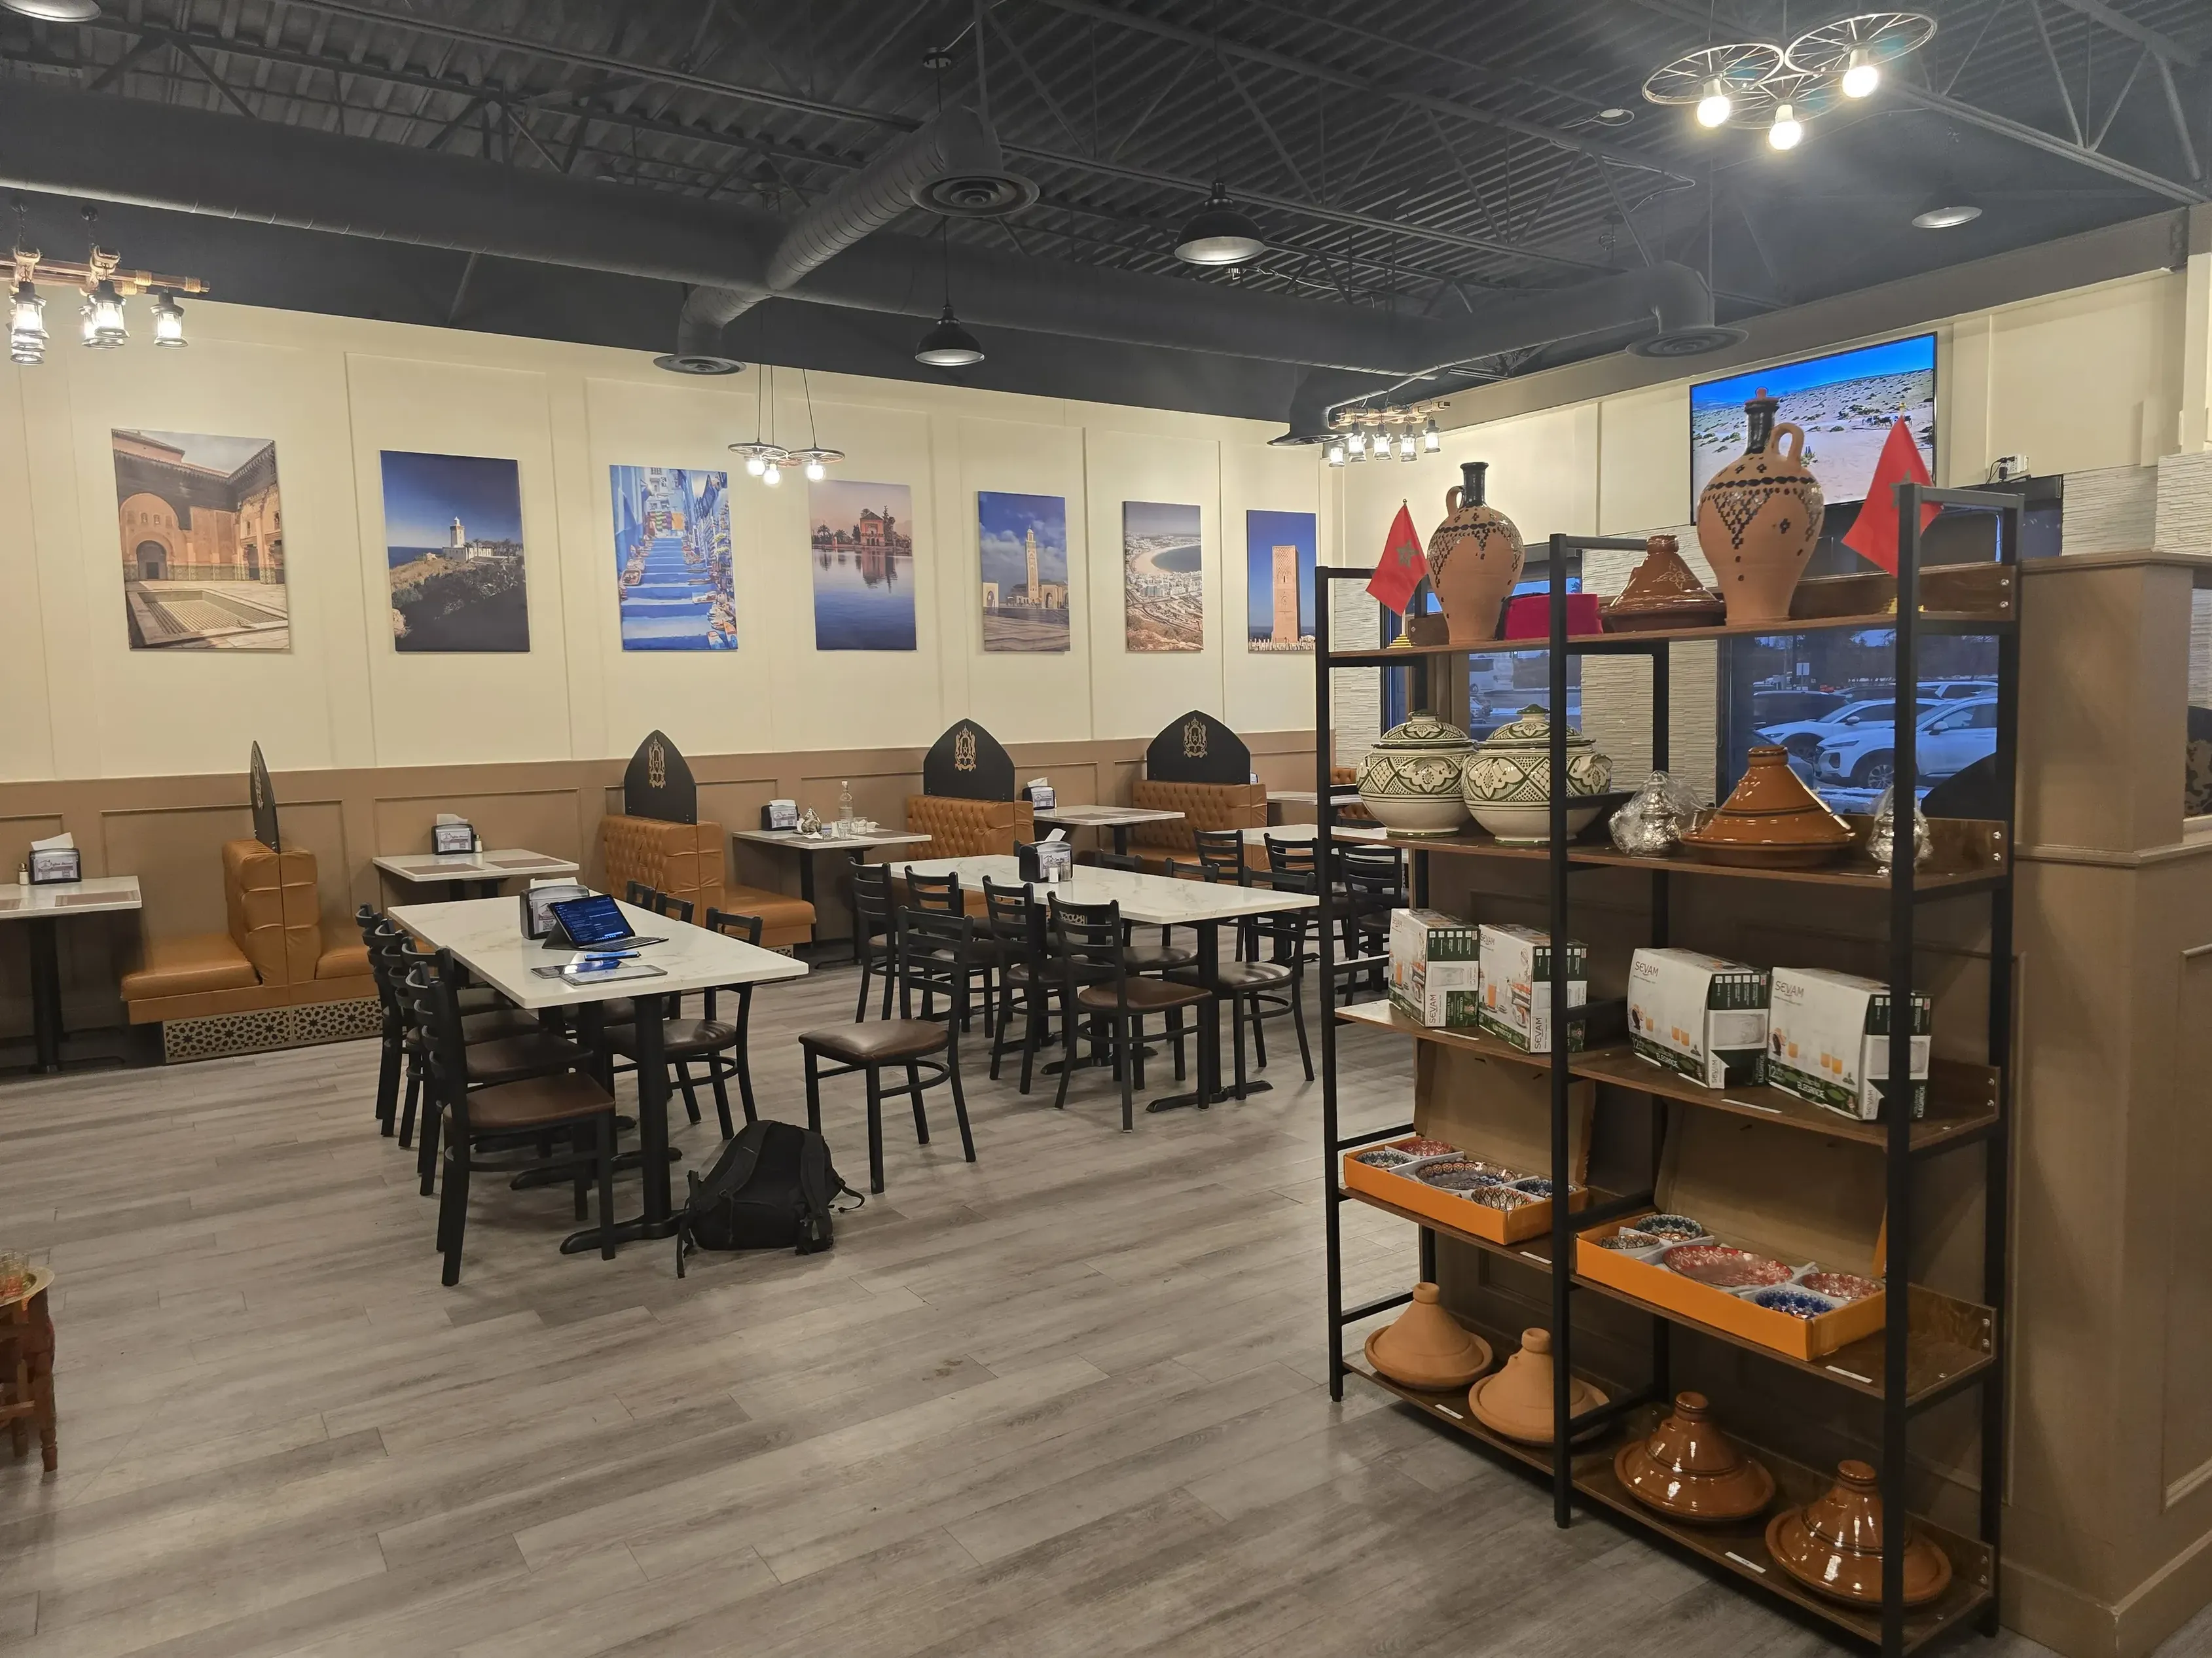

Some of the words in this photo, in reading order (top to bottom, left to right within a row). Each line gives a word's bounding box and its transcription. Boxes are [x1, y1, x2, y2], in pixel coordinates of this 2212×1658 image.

[1480, 933, 1495, 945] SEVAM
[1635, 961, 1659, 977] SEVAM
[1775, 981, 1804, 998] SEVAM
[1429, 994, 1438, 1024] SEVAM
[1534, 1017, 1544, 1050] SEVAM
[1768, 1064, 1776, 1078] 12
